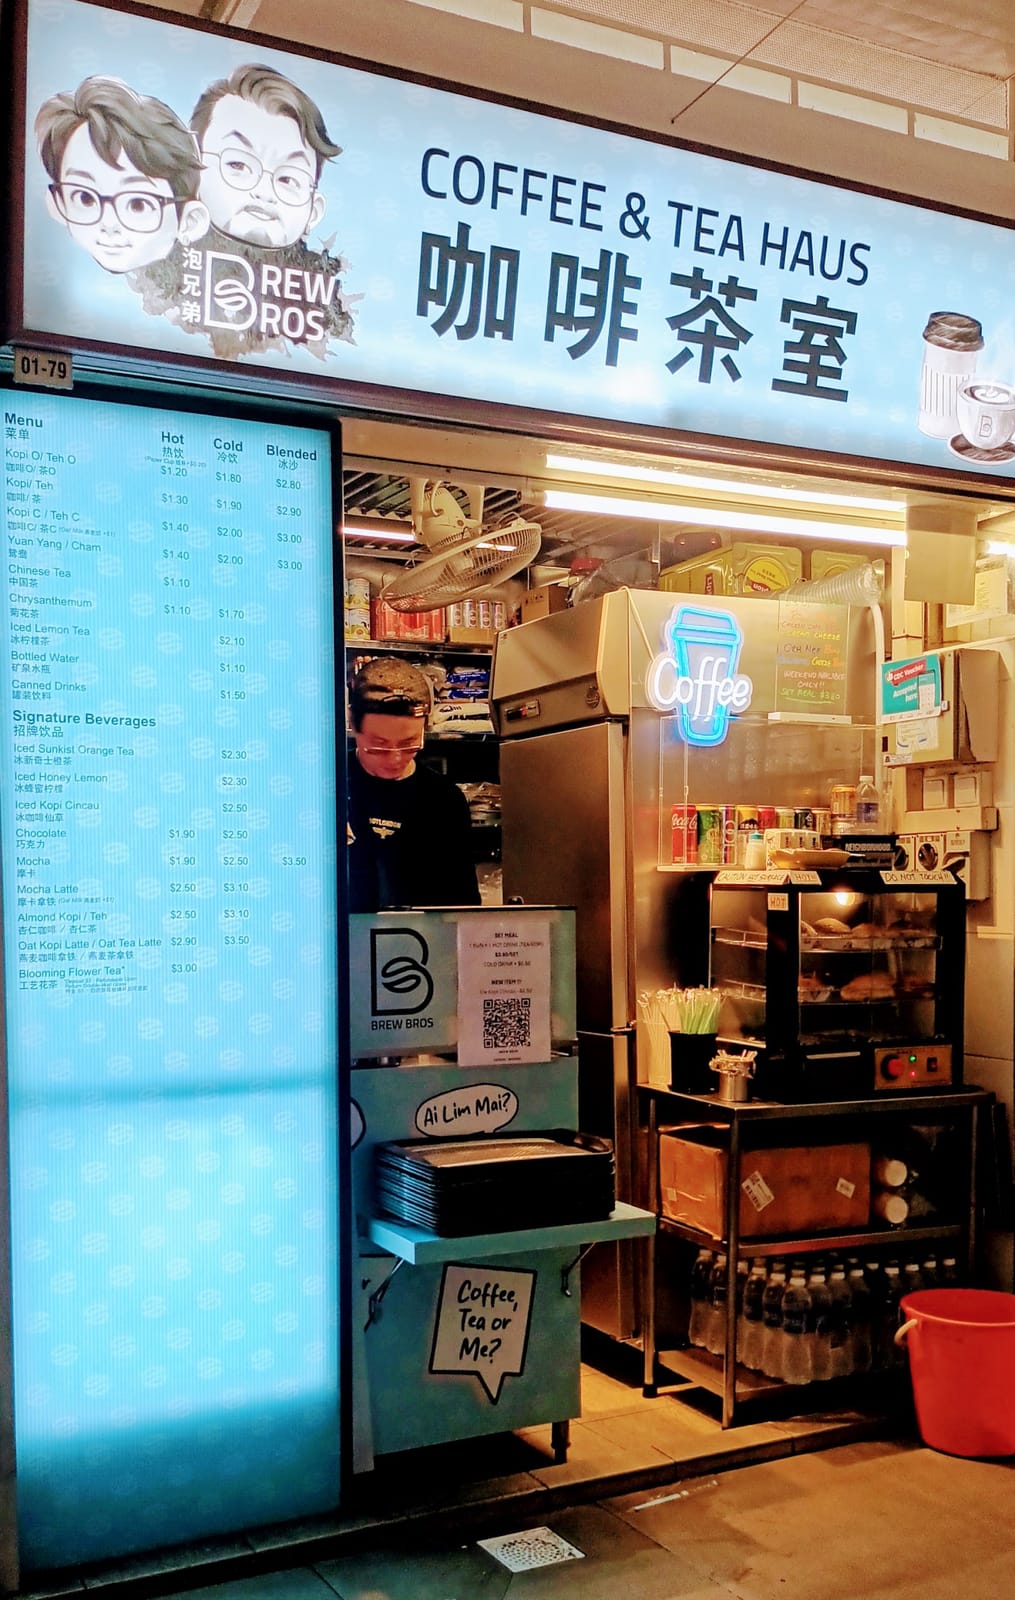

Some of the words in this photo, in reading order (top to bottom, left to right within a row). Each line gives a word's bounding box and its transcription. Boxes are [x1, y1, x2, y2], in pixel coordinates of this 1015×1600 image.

[420, 147, 607, 232] COFFEE
[618, 191, 652, 242] &
[667, 200, 746, 262] TEA
[759, 222, 872, 287] HAUS
[182, 247, 203, 324] 泡兄弟
[416, 221, 859, 403] 咖啡茶室
[20, 355, 68, 380] 01-79
[4, 412, 43, 428] Menu
[5, 427, 31, 440] 菜单
[161, 431, 185, 446] Hot
[213, 438, 244, 452] Cold
[5, 447, 28, 460] Kopi
[46, 452, 65, 463] Teh
[67, 454, 77, 465] O
[162, 446, 185, 459] 热饮
[217, 451, 239, 464] 冷饮
[266, 444, 318, 461] Blended
[277, 459, 299, 471] 冰沙
[160, 465, 188, 479] $1.20
[215, 471, 242, 484] $1.80
[35, 479, 54, 490] Teh
[275, 478, 301, 490] $2.80
[161, 493, 189, 505] $1.30
[216, 498, 242, 512] $1.90
[7, 506, 30, 518] Kopi
[32, 508, 41, 519] C
[50, 510, 69, 521] Teh
[72, 512, 81, 522] C
[276, 505, 302, 518] $2.90
[162, 520, 189, 533] $1.40
[217, 526, 243, 538] $2.00
[7, 535, 34, 547] Yuan
[36, 537, 63, 551] Yang
[71, 540, 102, 552] Cham
[276, 532, 302, 544] $3.00
[162, 548, 190, 561] $1.40
[217, 553, 244, 566] $2.00
[8, 563, 50, 577] Chinese
[53, 567, 72, 578] Tea
[277, 558, 303, 571] $3.00
[9, 577, 39, 589] 中国茶
[163, 576, 191, 588] $1.10
[9, 592, 93, 608] Chrysanthemum
[163, 604, 191, 616] $1.10
[218, 608, 245, 620] $1.70
[10, 622, 32, 633] Iced
[35, 623, 70, 635] Lemon
[72, 625, 91, 636] Tea
[219, 635, 245, 647] $2.10
[11, 650, 47, 662] Bottled
[49, 653, 80, 663] Water
[219, 662, 246, 674] $1.10
[12, 679, 52, 691] Canned
[55, 681, 87, 692] Drinks
[653, 655, 750, 722] Coffee
[220, 689, 246, 701] $1.50
[12, 709, 81, 725] Signature
[85, 712, 157, 729] Beverages
[13, 724, 64, 738] 招牌饮品
[13, 744, 35, 754] Iced
[38, 744, 75, 754] Sunkist
[78, 745, 115, 757] Orange
[117, 746, 135, 756] Tea
[221, 749, 247, 761] $2.30
[14, 772, 36, 782] Iced
[39, 772, 71, 784] Honey
[74, 773, 108, 783] Lemon
[221, 776, 248, 787] $2.30
[15, 800, 36, 810] Iced
[40, 800, 62, 811] Kopi
[65, 800, 99, 810] Cincau
[222, 802, 248, 813] $2.50
[15, 828, 67, 838] Chocolate
[168, 828, 196, 840] $1.90
[222, 829, 248, 840] $2.50
[16, 840, 45, 850] 巧克力
[16, 856, 51, 866] Mocha
[169, 855, 196, 867] $1.90
[223, 855, 249, 867] $2.50
[282, 855, 307, 867] $3.50
[900, 873, 915, 881] NOT
[17, 885, 51, 894] Mocha
[54, 885, 79, 894] Latte
[169, 882, 197, 894] $2.50
[223, 882, 249, 893] $3.10
[17, 912, 56, 922] Almond
[59, 911, 81, 923] Kopi
[90, 911, 108, 921] Teh
[170, 909, 197, 921] $2.50
[223, 908, 250, 920] $3.10
[18, 940, 37, 951] Oat
[39, 940, 62, 951] Kopi
[65, 939, 90, 949] Latte
[98, 938, 116, 948] Oat
[119, 938, 136, 947] Tea
[138, 937, 162, 947] Latte
[170, 935, 198, 947] $2.90
[224, 935, 250, 946] $3.50
[19, 968, 66, 980] Blooming
[68, 966, 102, 977] Flower
[171, 962, 198, 974] $3.00
[371, 1018, 403, 1031] BREW
[405, 1017, 434, 1029] BROS
[423, 1107, 438, 1128] Ai
[442, 1102, 471, 1124] Lim
[475, 1091, 512, 1113] Mai?
[457, 1279, 518, 1312] Coffee,
[459, 1308, 486, 1332] Tea
[491, 1317, 512, 1331] or
[459, 1337, 503, 1364] Me?
